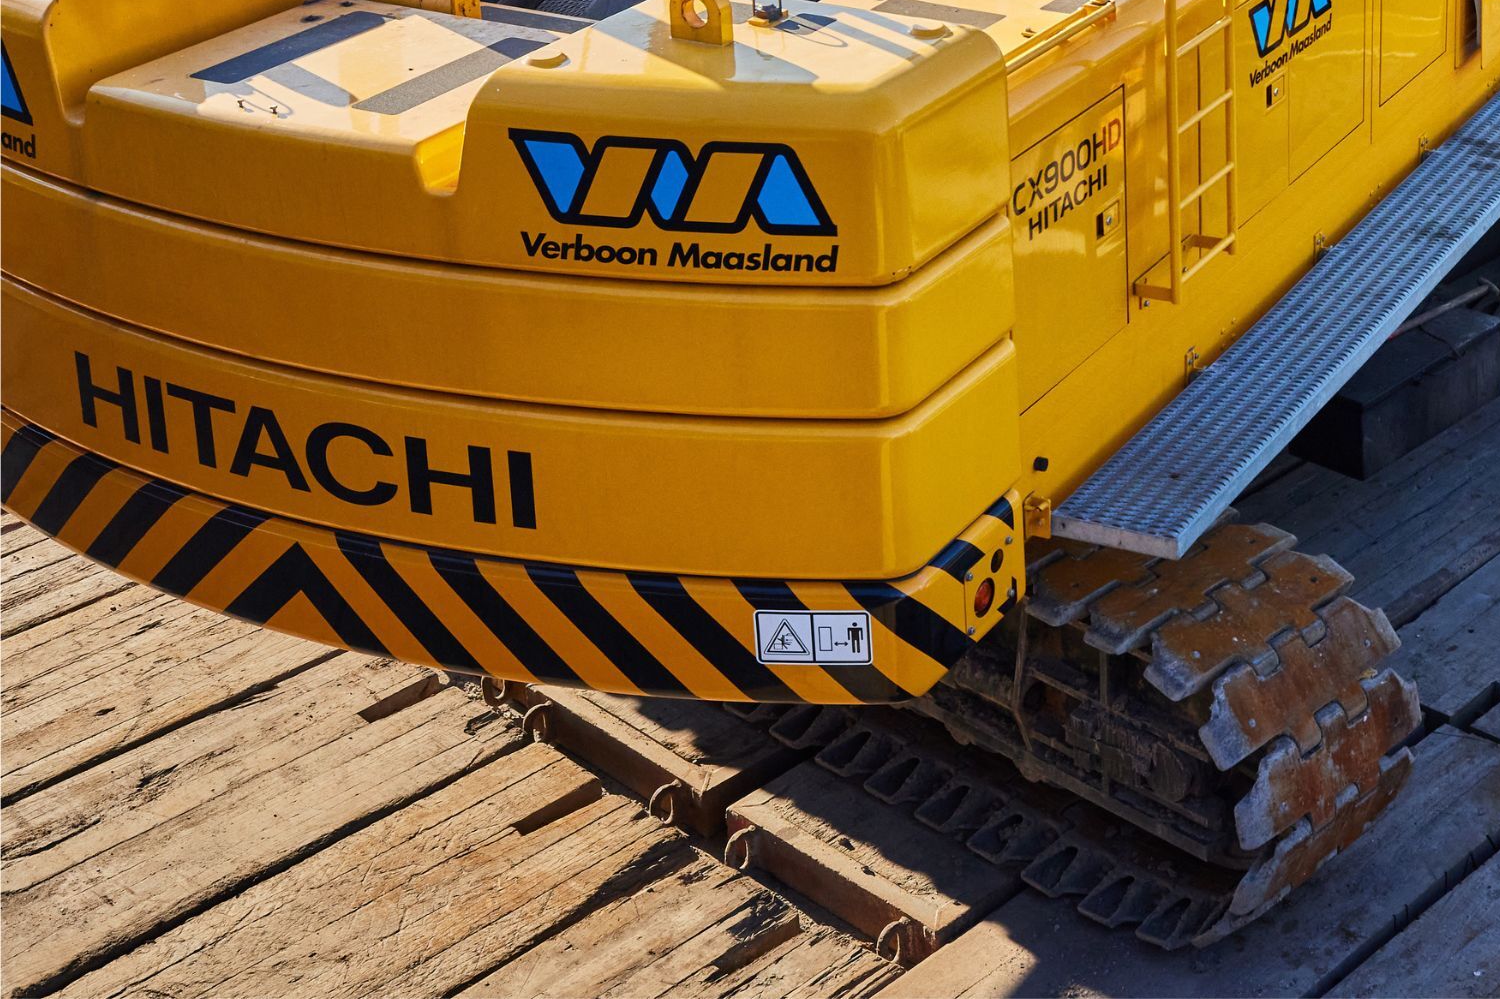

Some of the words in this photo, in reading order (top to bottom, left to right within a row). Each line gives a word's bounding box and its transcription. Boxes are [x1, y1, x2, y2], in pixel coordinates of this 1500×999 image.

[1249, 52, 1288, 88] Verboon
[1289, 13, 1333, 60] Maasland
[1012, 118, 1122, 216] CX900HD
[1028, 164, 1108, 241] HITACHI
[520, 231, 658, 266] Verboon
[667, 242, 840, 273] Maasland
[74, 350, 538, 530] HITACHI
